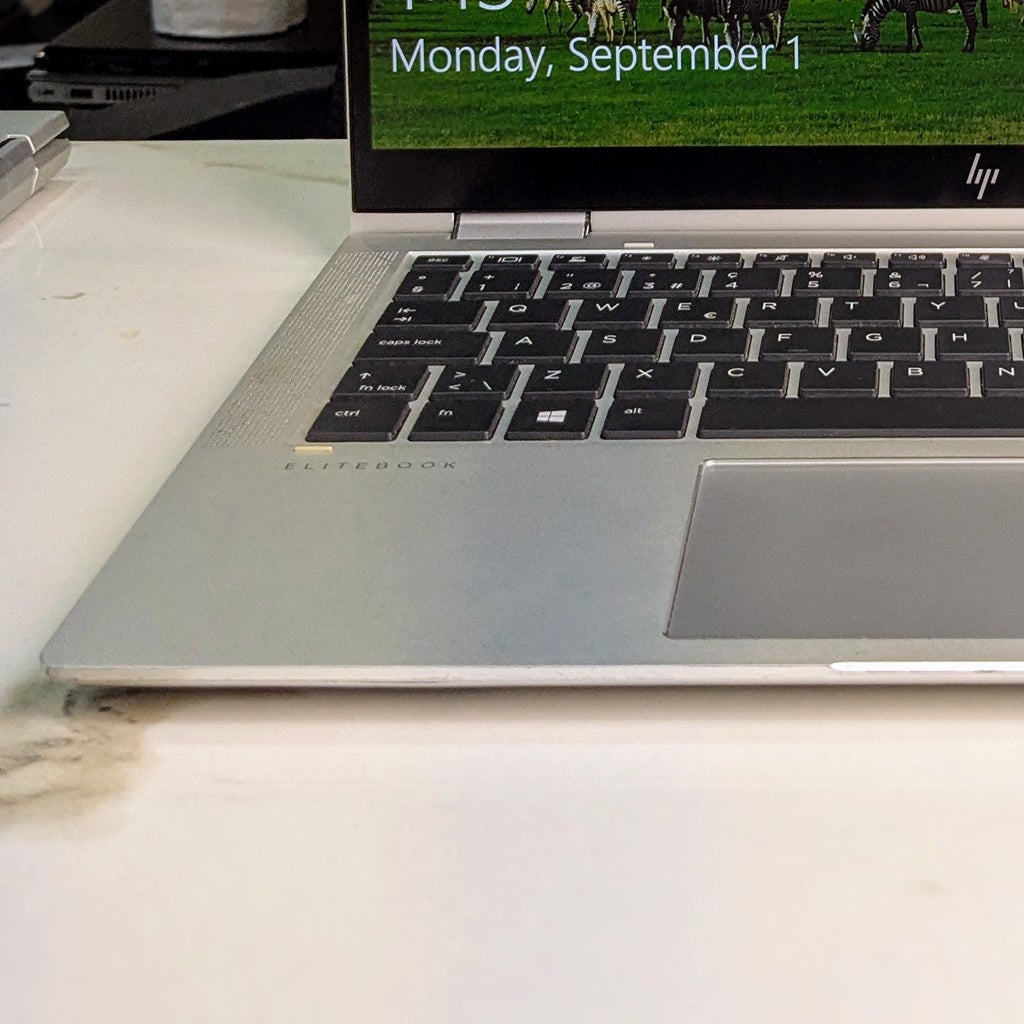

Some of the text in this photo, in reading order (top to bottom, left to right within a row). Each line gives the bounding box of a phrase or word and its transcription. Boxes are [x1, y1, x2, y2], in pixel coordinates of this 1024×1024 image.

[391, 35, 802, 83] Monday, September 1
[965, 152, 1001, 200] hp
[559, 282, 573, 290] 2
[582, 281, 602, 289] @
[642, 281, 655, 290] 3
[725, 281, 738, 289] 4
[807, 280, 820, 288] 5
[971, 280, 982, 289] 7
[508, 304, 528, 313] Q
[595, 302, 620, 312] W
[677, 302, 692, 311] E
[762, 302, 777, 310] R
[845, 301, 859, 310] T
[930, 301, 946, 310] Y
[378, 337, 442, 346] caps lock
[515, 336, 533, 345] A
[602, 334, 617, 344] S
[690, 334, 707, 343] D
[777, 333, 792, 342] F
[865, 332, 882, 342] G
[952, 332, 968, 342] H
[544, 369, 562, 380] Z
[636, 368, 654, 379] X
[727, 367, 745, 377] C
[818, 367, 836, 377] V
[907, 367, 924, 376] B
[998, 367, 1015, 376] N
[358, 383, 407, 392] fn lock
[334, 409, 360, 417] ctrl
[285, 461, 458, 470] ELITEBOOK
